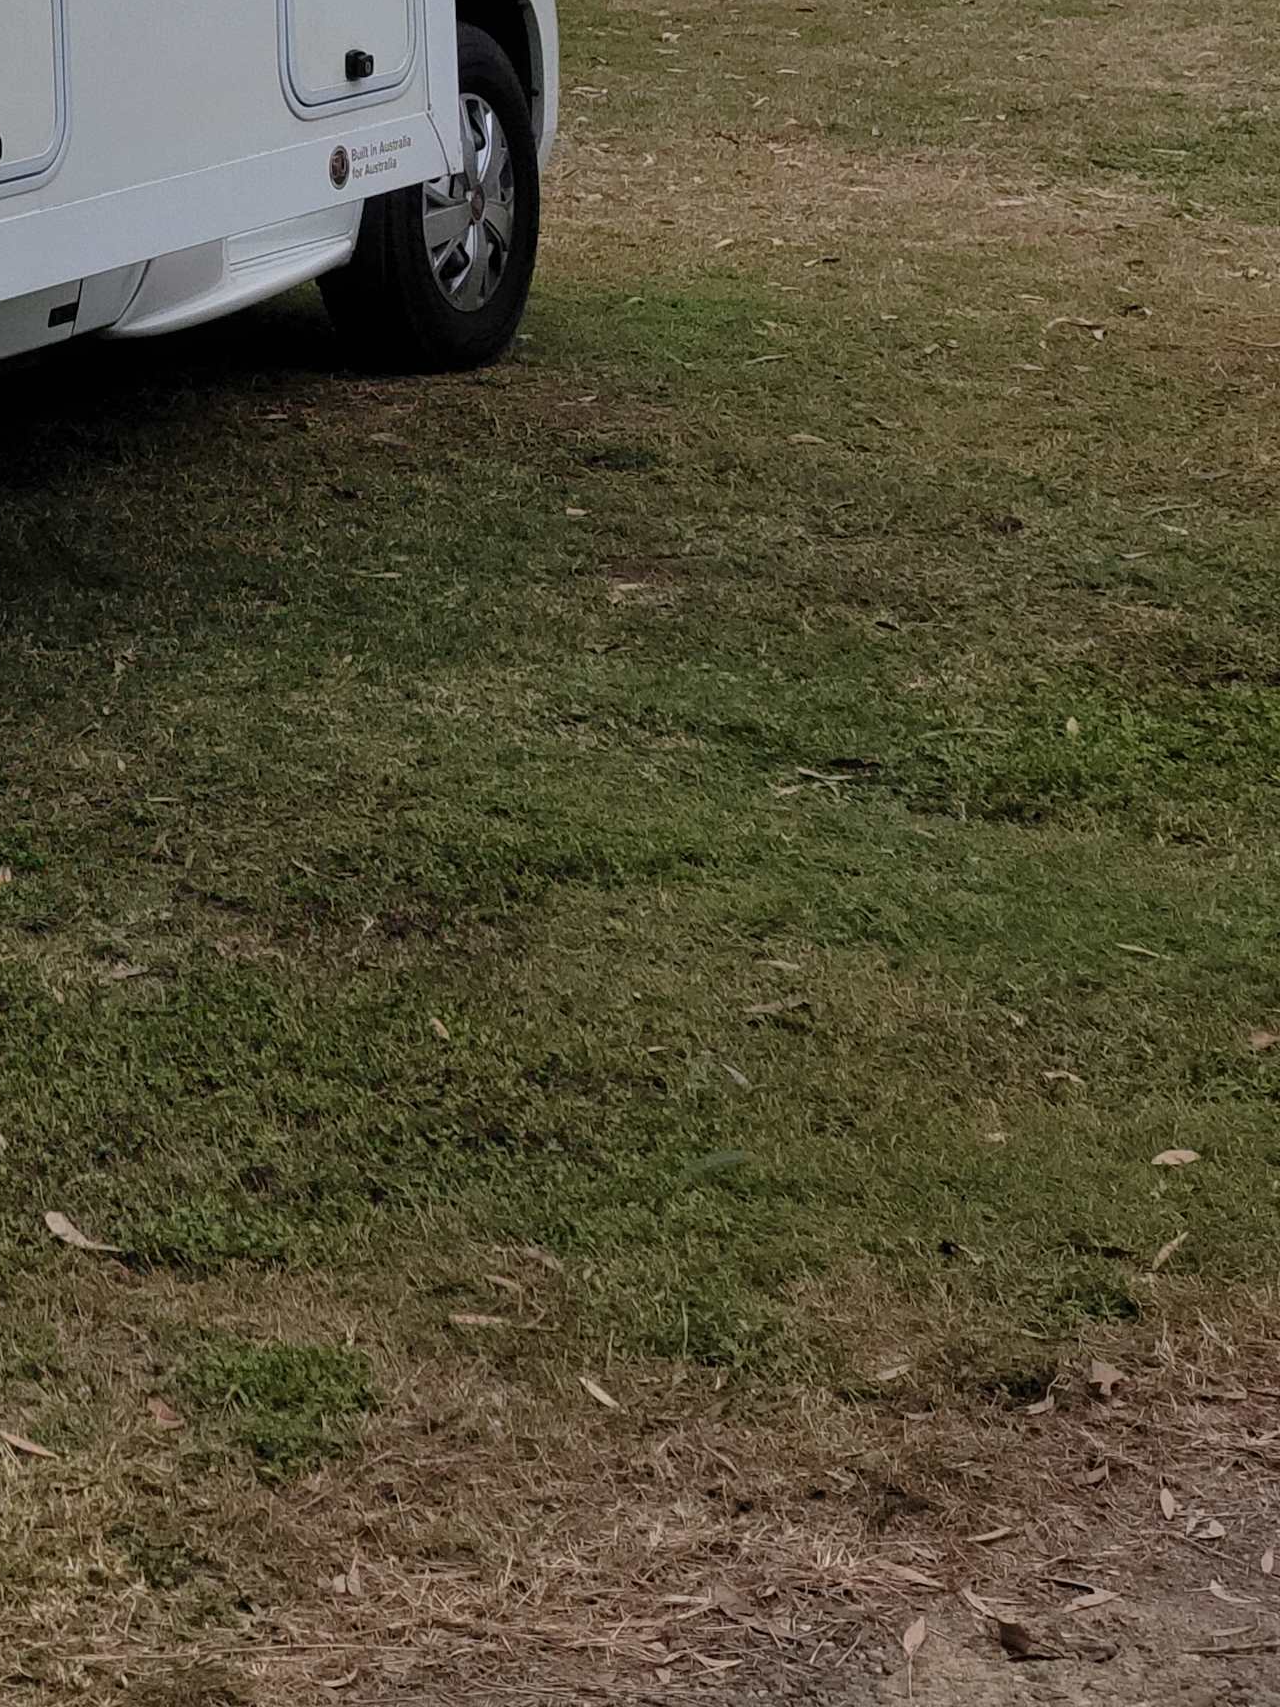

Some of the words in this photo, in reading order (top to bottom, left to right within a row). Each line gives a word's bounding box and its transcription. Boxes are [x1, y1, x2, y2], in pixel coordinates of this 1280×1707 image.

[351, 146, 368, 162] Built
[370, 143, 378, 156] in
[379, 135, 412, 156] Australia
[352, 166, 364, 179] for
[364, 157, 397, 176] Australia
